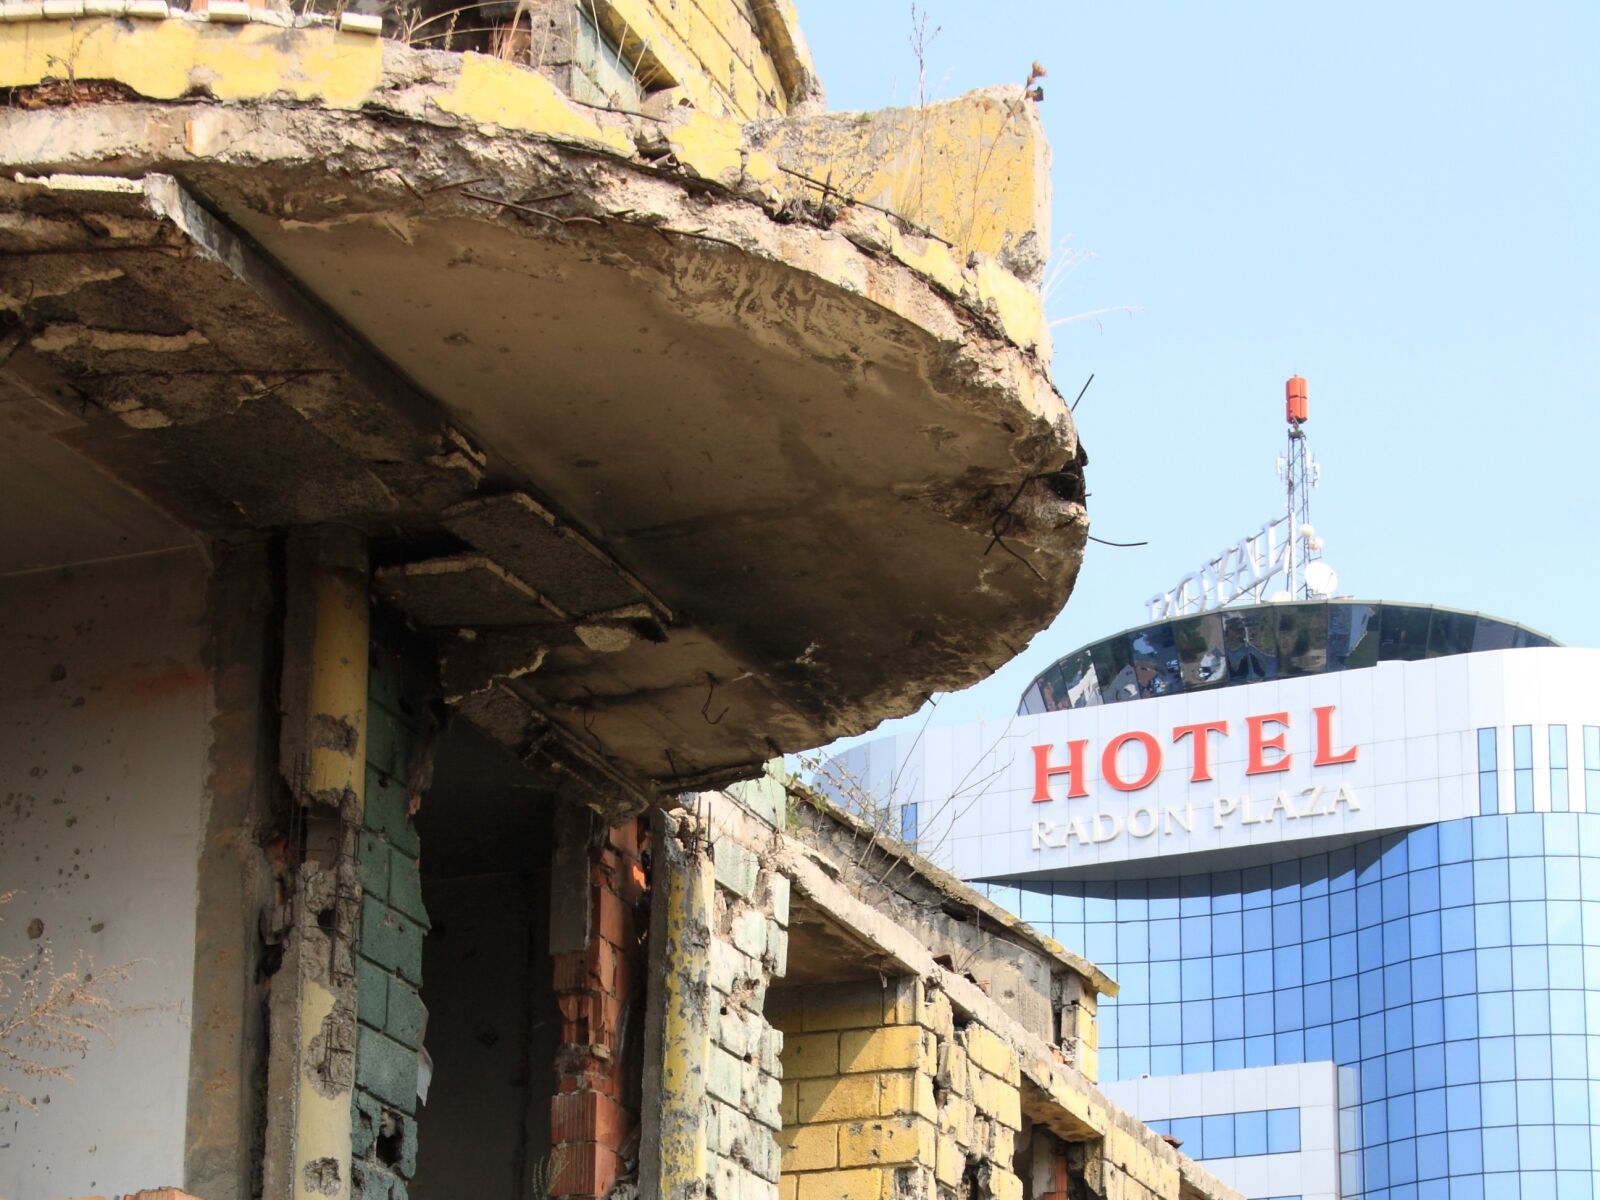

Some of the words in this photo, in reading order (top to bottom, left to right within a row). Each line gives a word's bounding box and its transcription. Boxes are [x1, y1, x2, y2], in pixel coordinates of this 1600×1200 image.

[1031, 705, 1358, 802] HOTEL
[1032, 803, 1192, 850] RADON
[1213, 783, 1360, 828] PLAZA
